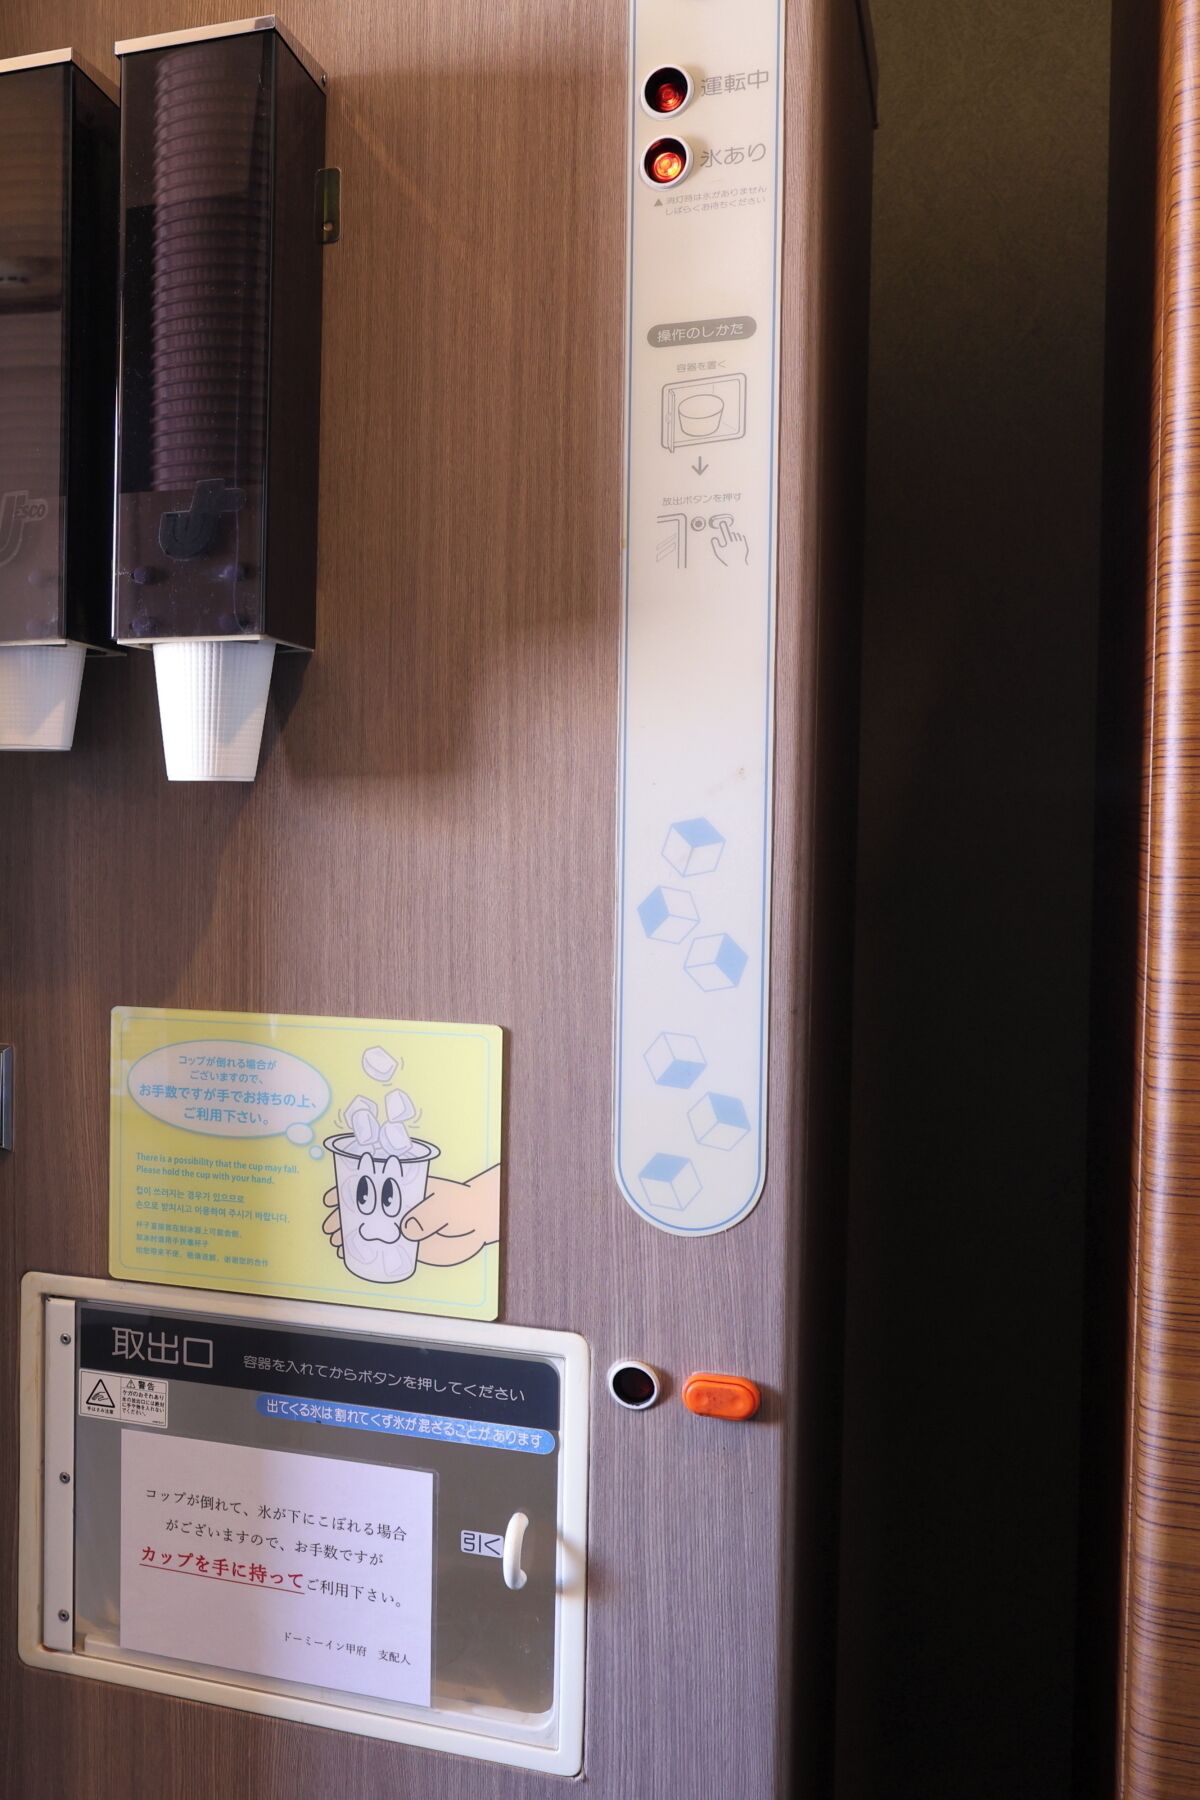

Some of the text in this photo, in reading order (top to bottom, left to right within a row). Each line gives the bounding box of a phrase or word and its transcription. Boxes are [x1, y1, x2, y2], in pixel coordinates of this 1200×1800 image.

[701, 69, 769, 97] 運転中
[700, 143, 766, 167] 氷あり
[666, 197, 766, 216] しばらくお待ちください
[657, 323, 743, 342] 操作のしかた
[676, 360, 727, 373] 容器を置く
[662, 493, 741, 506] 放出ボタンを押す
[178, 1055, 277, 1071] コップが倒れる場合が
[189, 1070, 264, 1085] ございますので、
[139, 1084, 317, 1109] お手数ですが手でお持ちの上、
[184, 1107, 269, 1126] ご利用下さい。
[136, 1152, 158, 1162] There
[159, 1154, 166, 1162] is
[173, 1155, 214, 1168] possibility
[215, 1159, 232, 1168] that
[233, 1160, 247, 1169] the
[248, 1162, 263, 1172] cup
[264, 1164, 281, 1173] may
[283, 1164, 300, 1174] fall.
[136, 1165, 275, 1185] Please hold the cup with your hand.
[112, 1327, 214, 1369] 取出口
[138, 1381, 155, 1391] 警告
[243, 1355, 525, 1402] 容器を入れてからボタンを押してください
[122, 1389, 164, 1400] ケガのおそれあり
[146, 1489, 408, 1542] コップが倒れて、氷が下にこぼれる場合
[165, 1519, 384, 1566] がございますので、お手数ですが
[463, 1532, 501, 1556] 引く
[285, 1632, 411, 1666] ドーミーイン甲府 支配人
